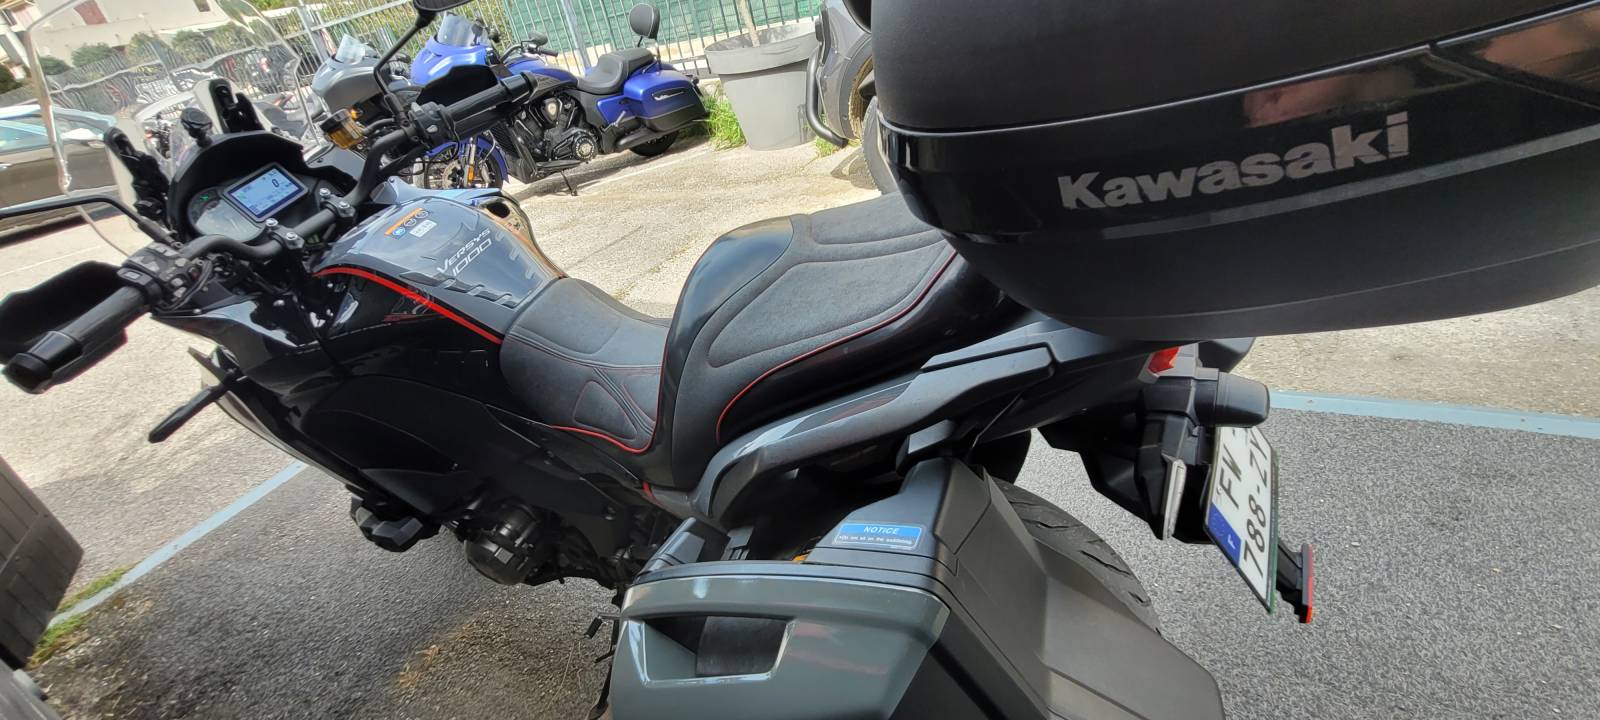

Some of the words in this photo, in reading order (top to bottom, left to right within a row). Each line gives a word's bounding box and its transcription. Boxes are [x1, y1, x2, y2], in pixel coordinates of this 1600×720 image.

[1057, 111, 1410, 210] Kawasaki
[437, 228, 491, 274] VERSYS
[452, 238, 492, 276] 1000
[863, 526, 900, 535] NOTICE
